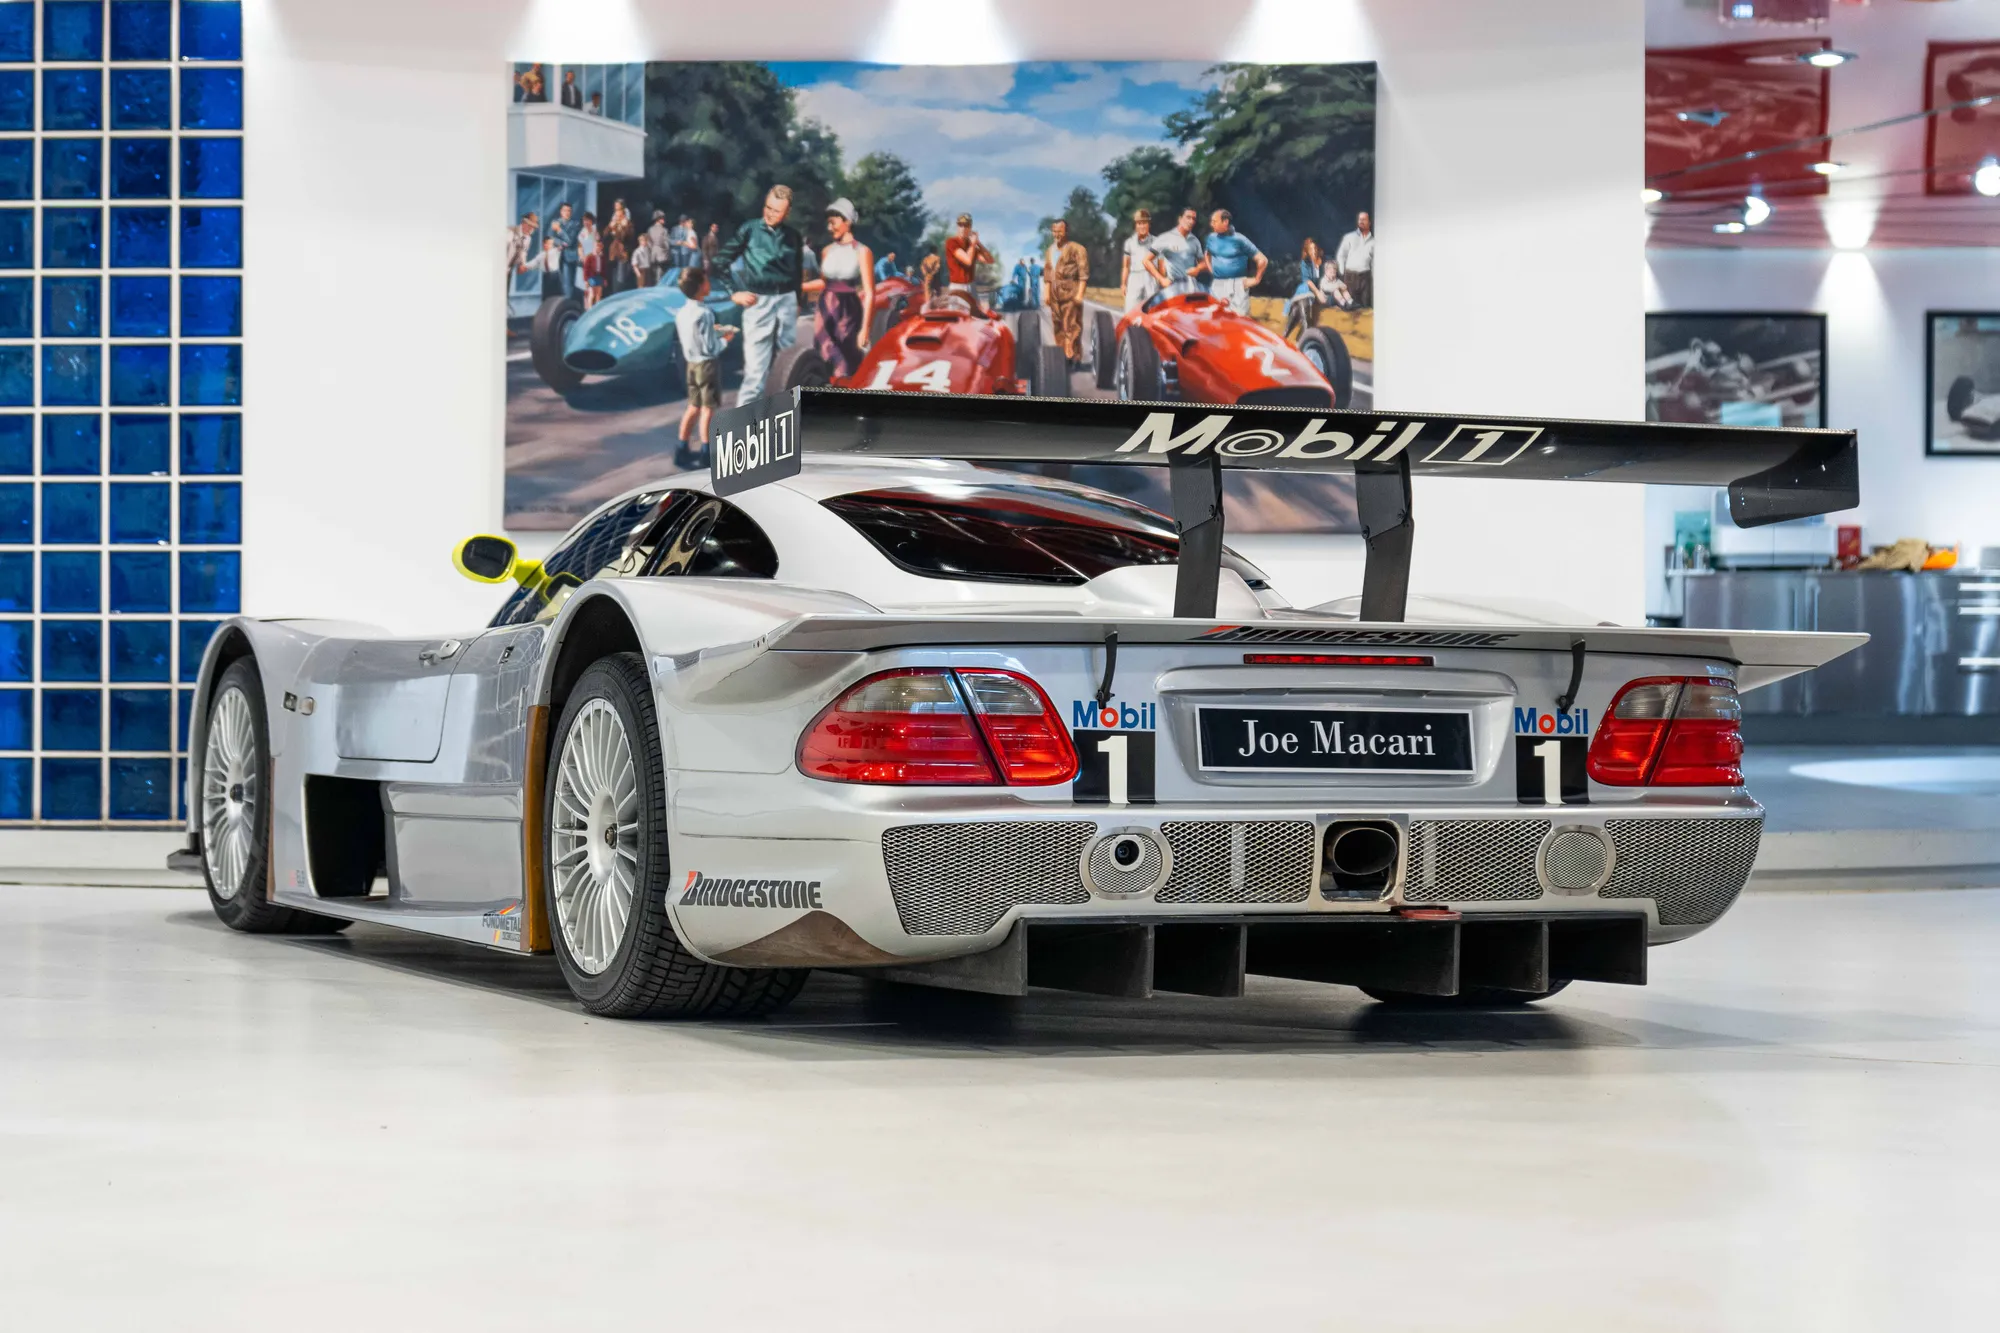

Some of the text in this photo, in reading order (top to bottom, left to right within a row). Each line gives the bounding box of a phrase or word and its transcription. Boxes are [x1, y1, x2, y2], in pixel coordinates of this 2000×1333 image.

[605, 316, 648, 346] 18
[863, 359, 952, 392] 14
[1245, 345, 1292, 377] 2
[716, 418, 770, 479] Mobil
[1115, 412, 1504, 462] Mobil 1
[1185, 624, 1519, 647] BRIDGESTONE
[1072, 700, 1156, 730] Mobil
[1514, 707, 1589, 735] Mobil
[1238, 719, 1436, 757] Joe Macari
[1097, 735, 1131, 804] 1
[1533, 740, 1567, 805] 1
[679, 871, 823, 909] BRIDGESTONE
